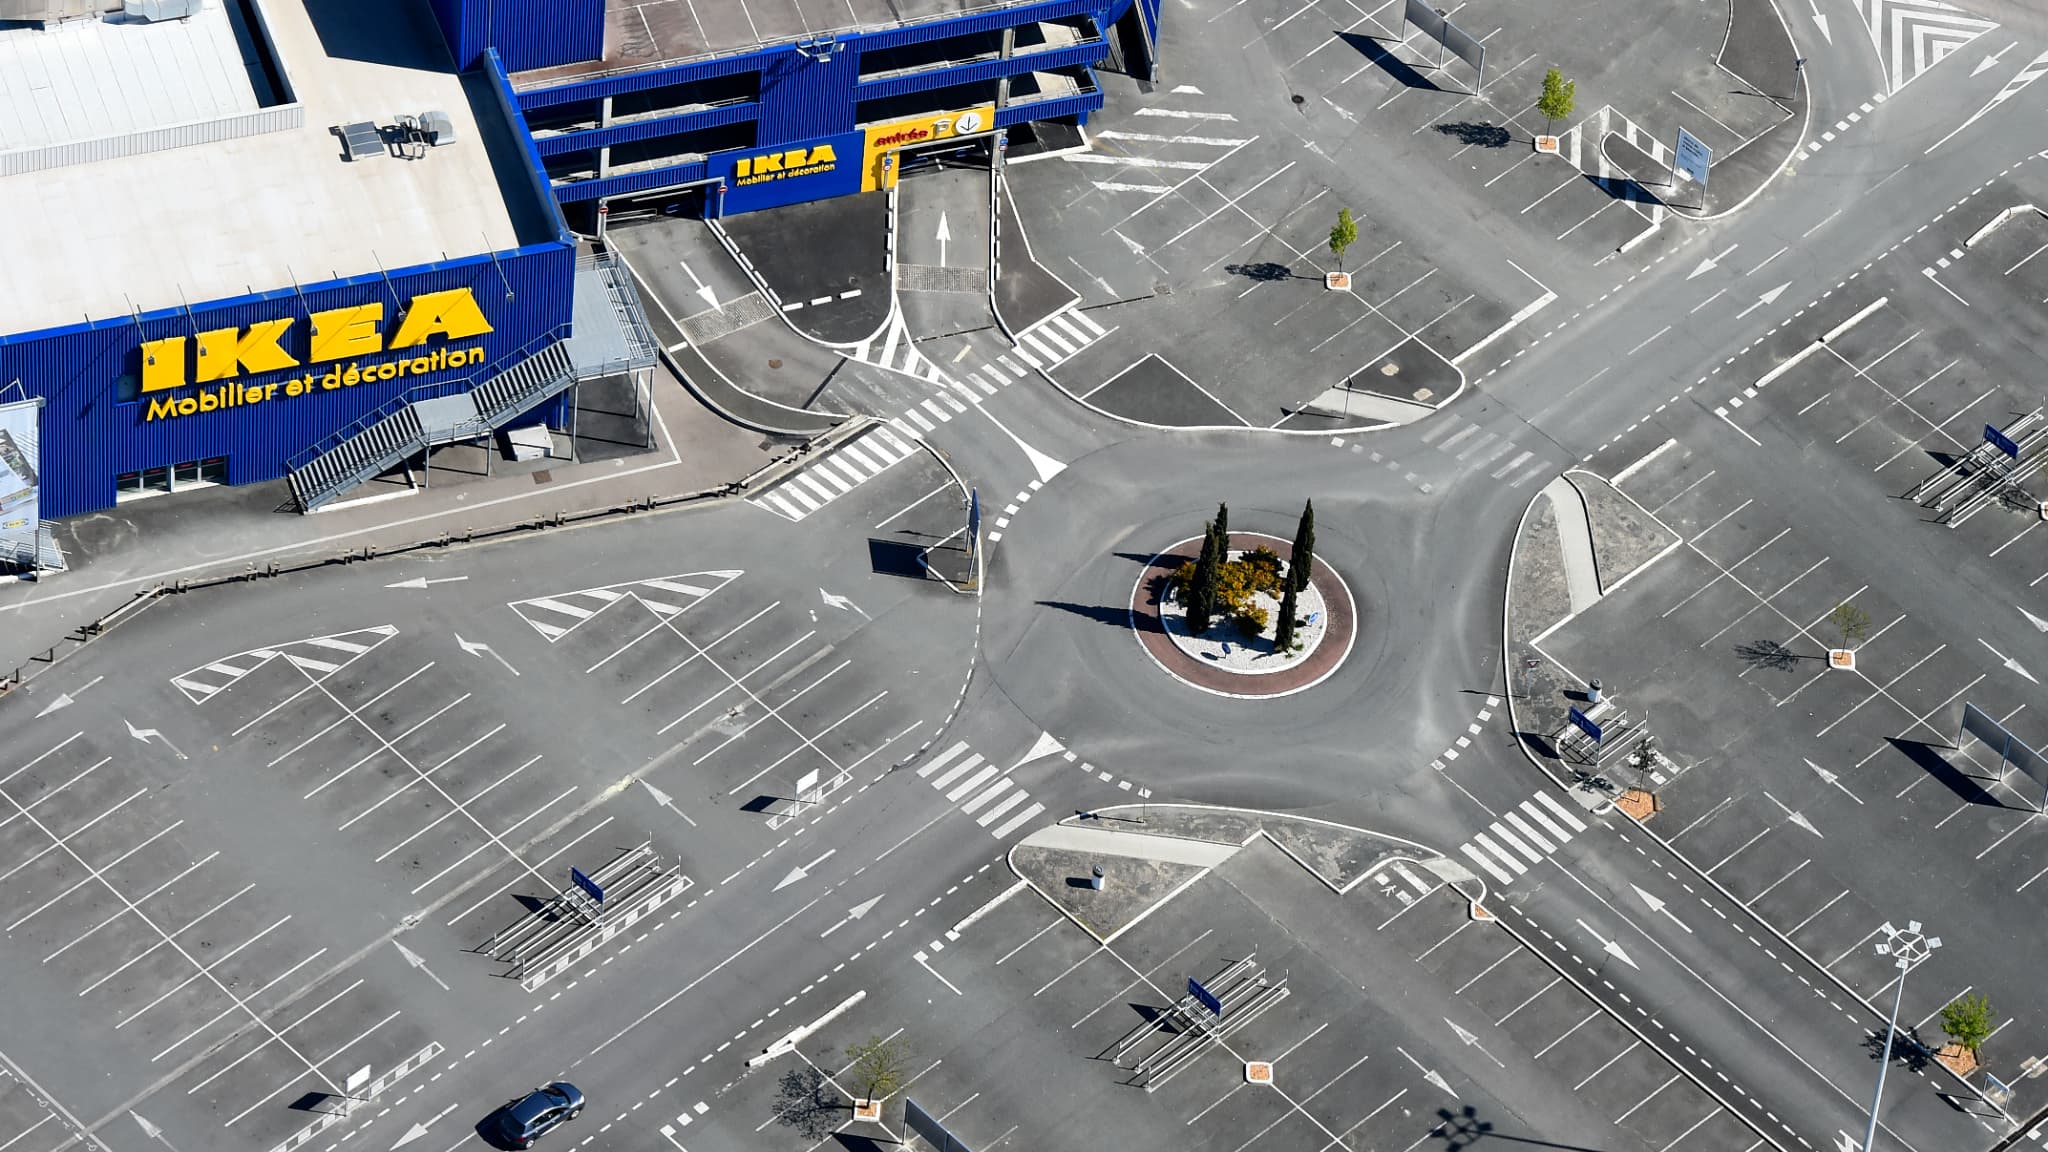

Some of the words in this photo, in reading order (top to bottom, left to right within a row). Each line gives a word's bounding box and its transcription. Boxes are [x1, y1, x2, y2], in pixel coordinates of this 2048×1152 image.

[877, 128, 929, 146] entrée
[736, 172, 775, 187] Mobilier
[776, 171, 786, 180] et
[787, 163, 836, 178] décoration
[737, 144, 837, 178] IKEA
[140, 286, 495, 393] IKEA
[146, 382, 278, 422] Mobilier
[285, 373, 314, 397] et
[321, 346, 486, 390] décoration
